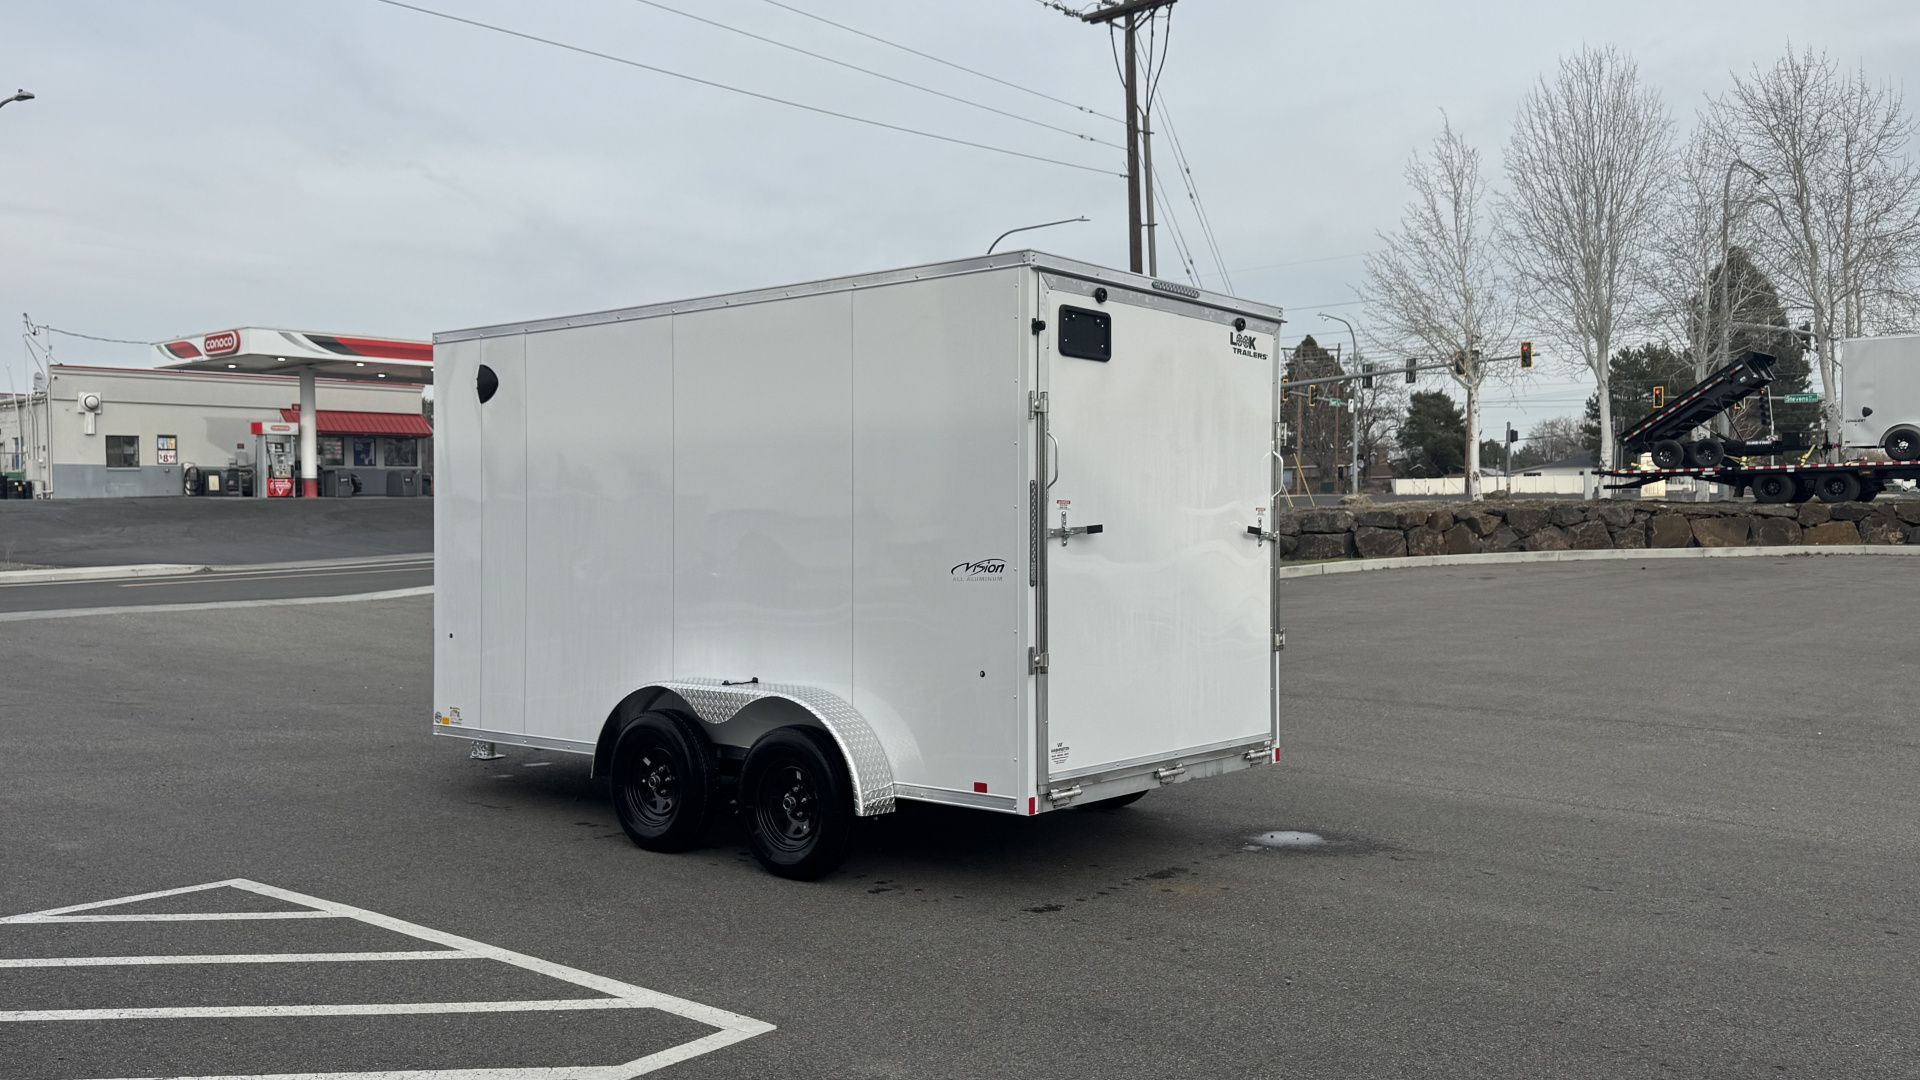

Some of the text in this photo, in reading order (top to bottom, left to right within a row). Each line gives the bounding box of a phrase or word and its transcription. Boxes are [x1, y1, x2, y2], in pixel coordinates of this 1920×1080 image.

[1230, 331, 1257, 350] LOOK
[1232, 347, 1267, 360] TRAILERS
[1785, 395, 1809, 403] Stevens
